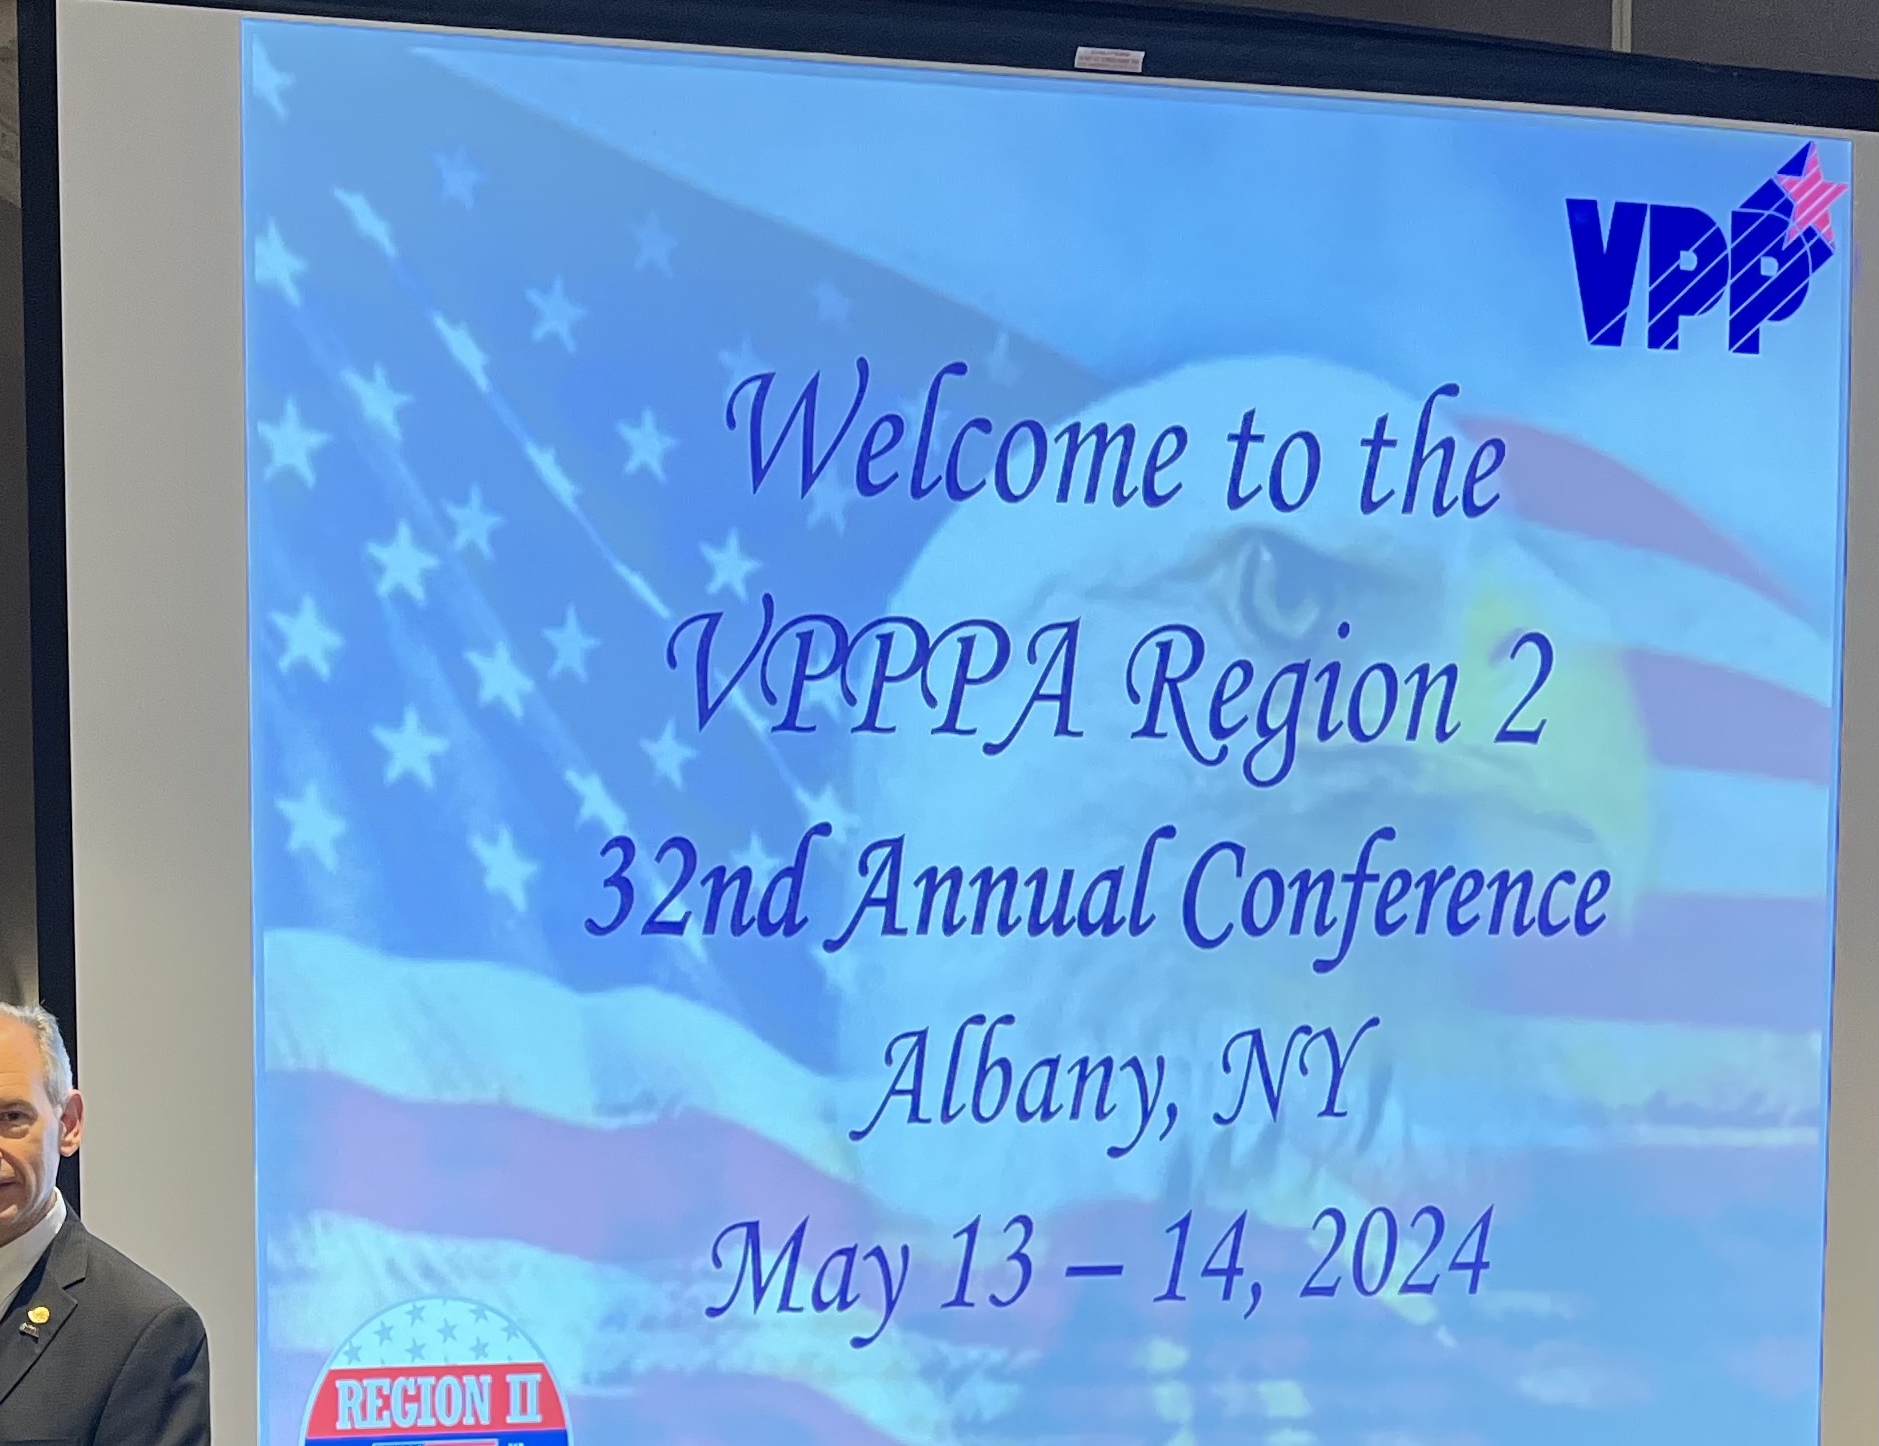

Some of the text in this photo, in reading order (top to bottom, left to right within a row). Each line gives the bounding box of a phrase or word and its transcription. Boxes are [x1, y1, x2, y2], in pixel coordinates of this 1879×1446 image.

[1565, 198, 1814, 354] VPP
[727, 356, 1506, 517] Welcome to the
[667, 594, 1554, 787] VPPPA Region 2
[584, 823, 1611, 973] 32nd Annual Conference
[849, 1014, 1380, 1158] Albany, NY
[705, 1217, 909, 1348] May
[940, 1215, 1034, 1309] 13
[1154, 1210, 1263, 1318] 14,
[1300, 1205, 1493, 1297] 2024
[335, 1373, 543, 1430] REGION II
